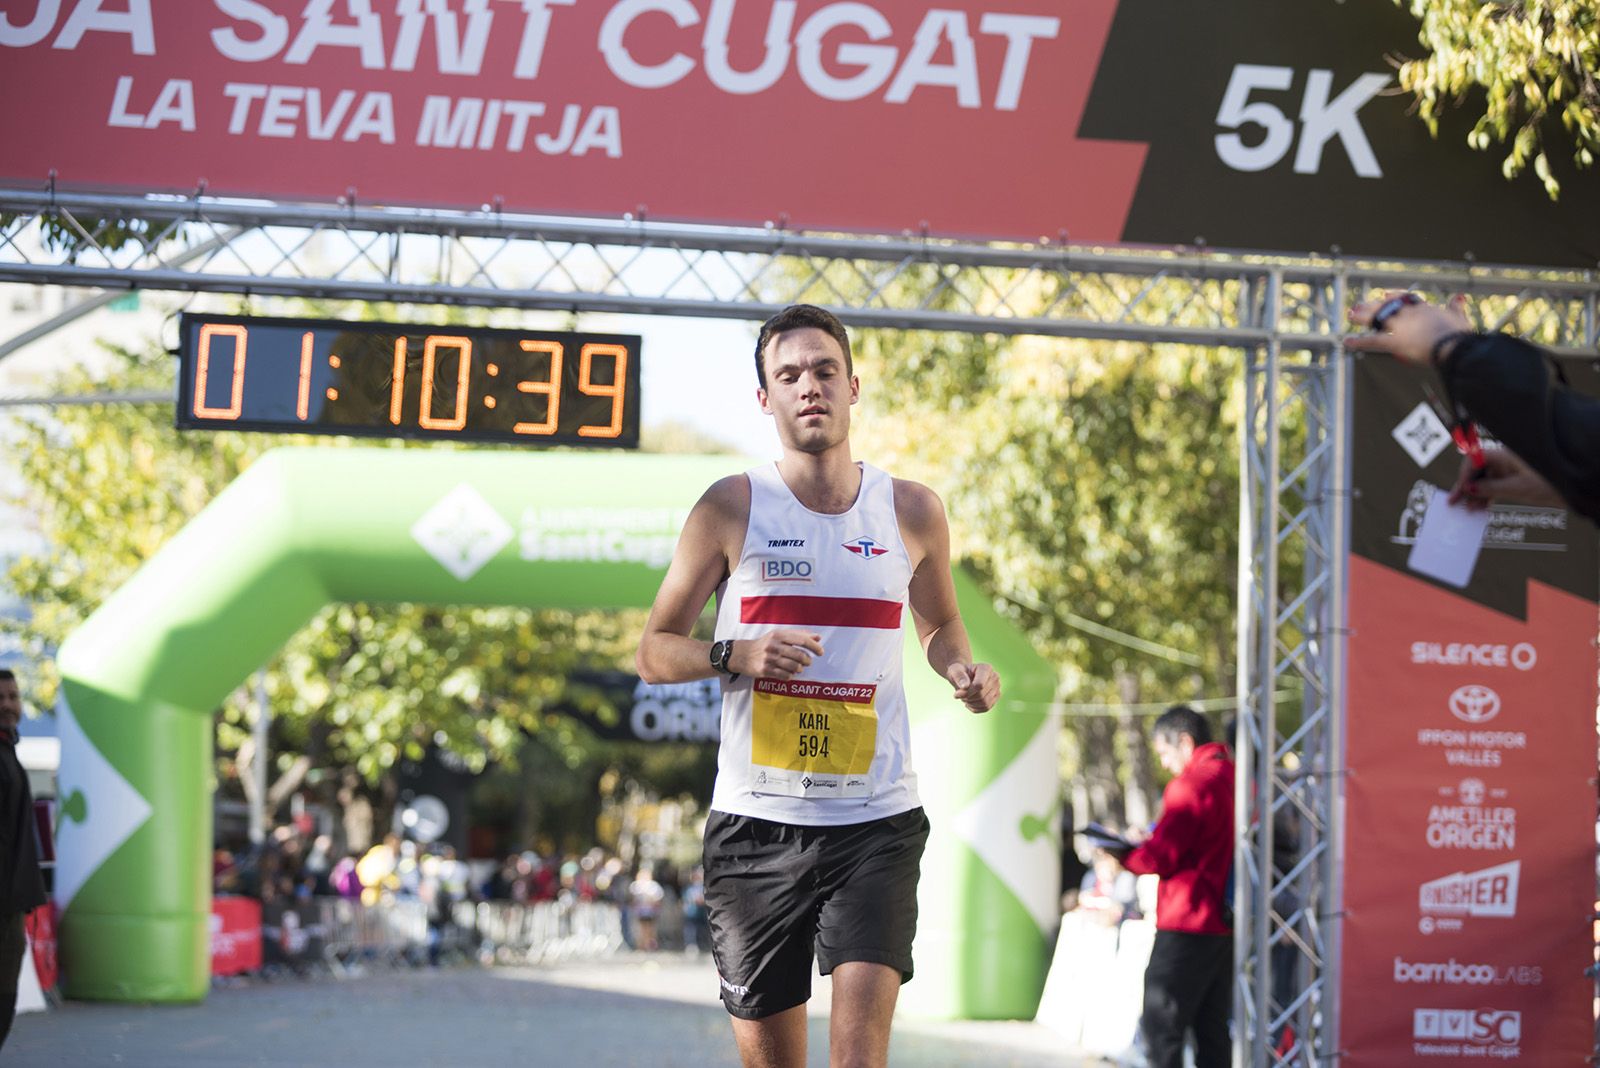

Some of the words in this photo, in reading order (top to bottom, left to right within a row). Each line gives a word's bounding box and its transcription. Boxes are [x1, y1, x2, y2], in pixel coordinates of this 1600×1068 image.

[210, 0, 577, 79] SANT
[598, 0, 1060, 110] CUGAT
[108, 76, 196, 131] LA
[223, 83, 396, 144] TEVA
[416, 96, 623, 158] MITJA
[1215, 64, 1393, 178] 5K
[193, 323, 627, 438] 01:10:39
[768, 539, 805, 548] TRIMTEX
[858, 541, 874, 557] T
[767, 560, 812, 577] BDO
[1411, 641, 1508, 667] SILENCE
[758, 680, 788, 693] MITJA
[791, 684, 822, 695] SANT
[799, 712, 830, 731] KARL
[799, 735, 829, 757] 594
[1417, 729, 1467, 746] IPPON
[1469, 731, 1526, 748] MOTOR
[1428, 805, 1516, 823] AMETLLER
[1426, 823, 1516, 849] ORIGEN
